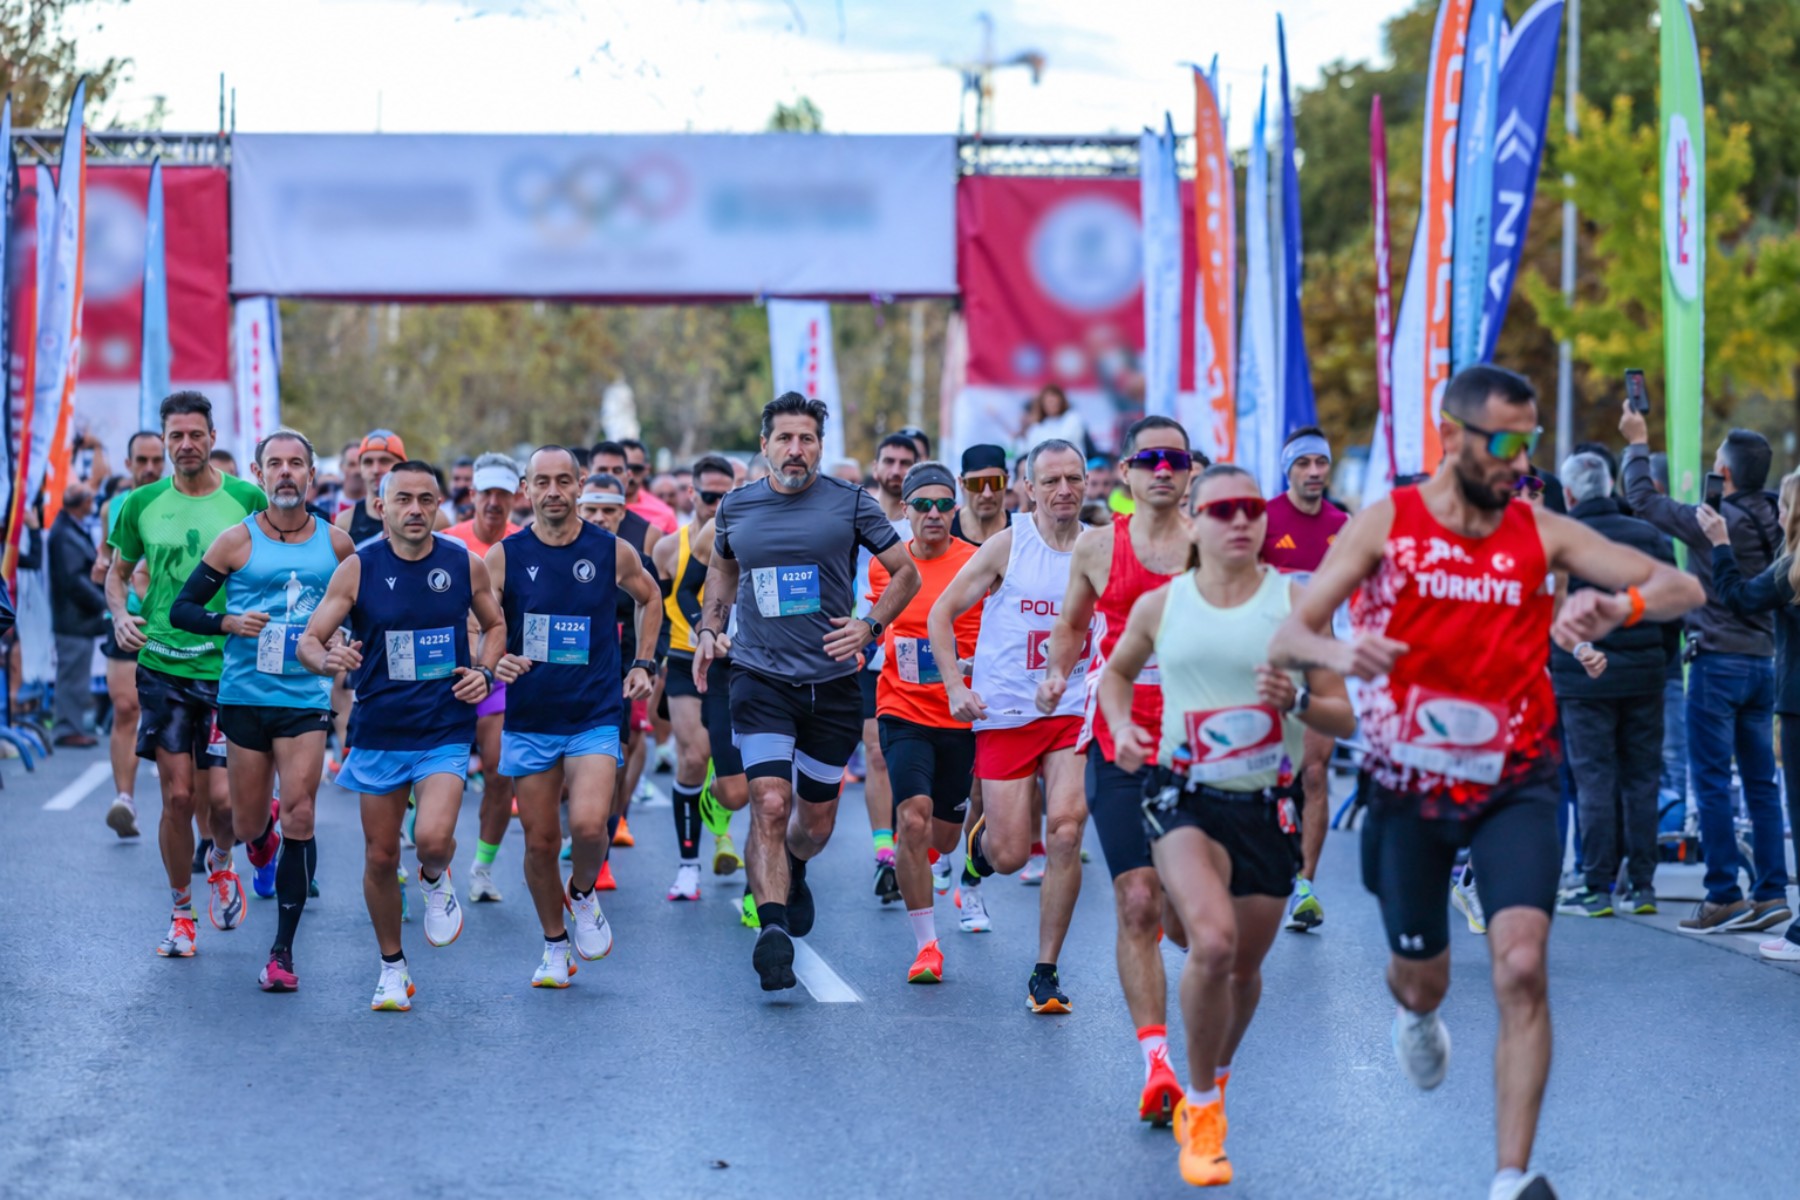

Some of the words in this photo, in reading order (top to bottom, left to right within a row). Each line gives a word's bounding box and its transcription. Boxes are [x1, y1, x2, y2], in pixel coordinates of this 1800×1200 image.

[782, 571, 813, 582] 42207
[1415, 568, 1522, 607] TÜRKİYE
[419, 634, 450, 645] 42225
